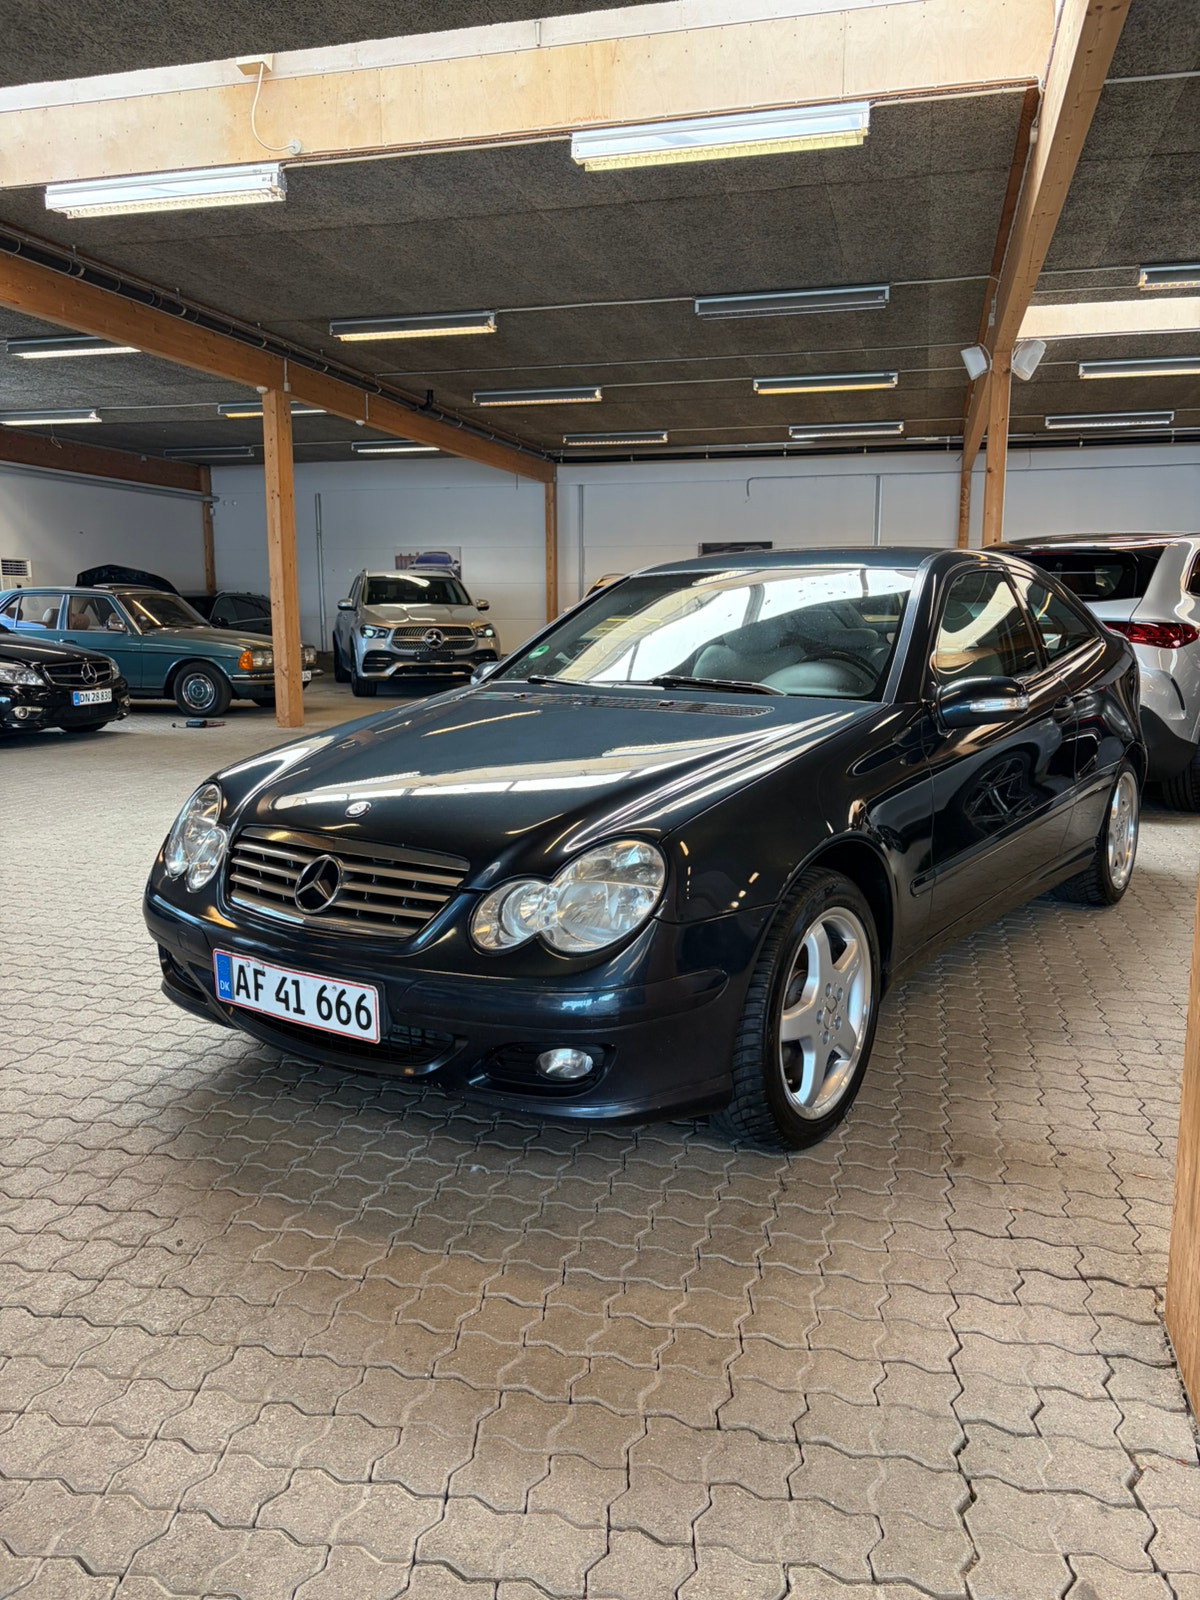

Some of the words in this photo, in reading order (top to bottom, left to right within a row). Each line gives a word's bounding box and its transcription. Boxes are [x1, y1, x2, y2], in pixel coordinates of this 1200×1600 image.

[91, 692, 100, 702] 28
[220, 980, 230, 991] DK
[235, 964, 266, 1001] AF
[275, 976, 305, 1016] 41
[317, 984, 372, 1030] 666
